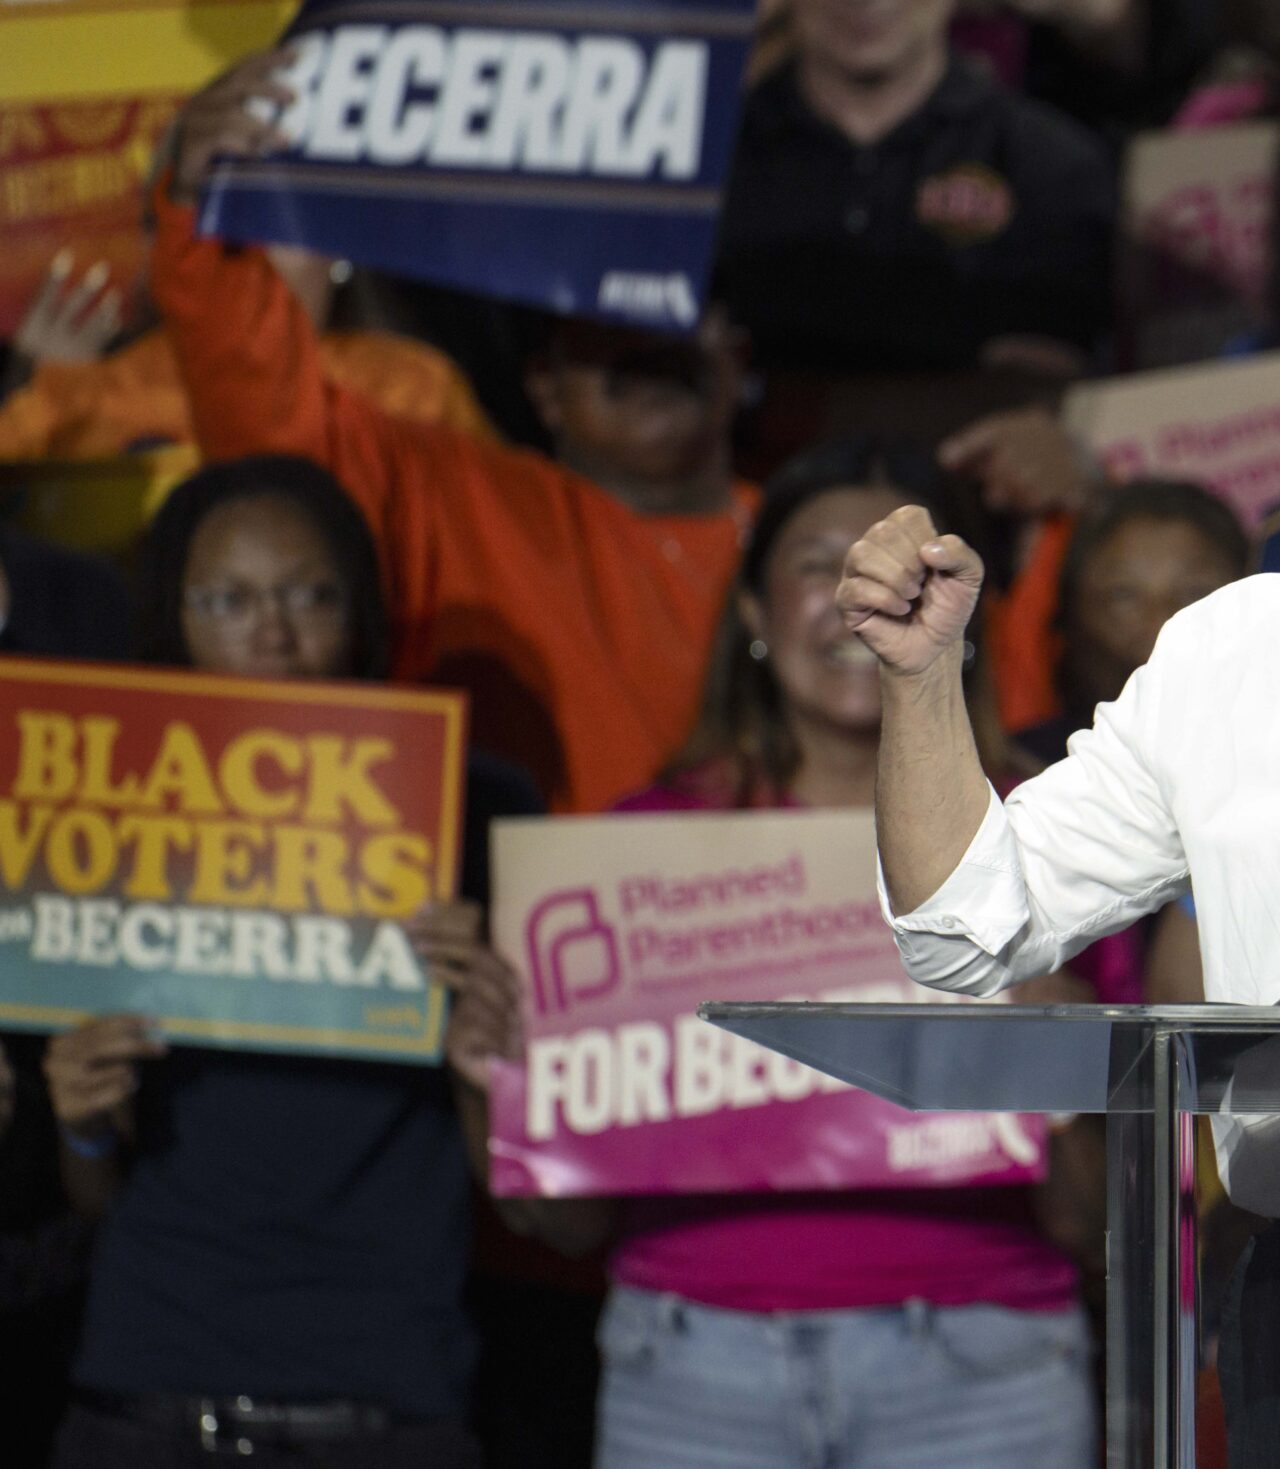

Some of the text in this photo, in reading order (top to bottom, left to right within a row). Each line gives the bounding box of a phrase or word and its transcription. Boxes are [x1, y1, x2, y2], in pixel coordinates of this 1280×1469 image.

[14, 710, 398, 828] BLACK
[0, 806, 436, 920] VOTERS
[619, 854, 806, 916] Planned
[30, 892, 427, 992] BECERRA
[629, 902, 883, 968] Parenthoo
[525, 1018, 672, 1141] FOR
